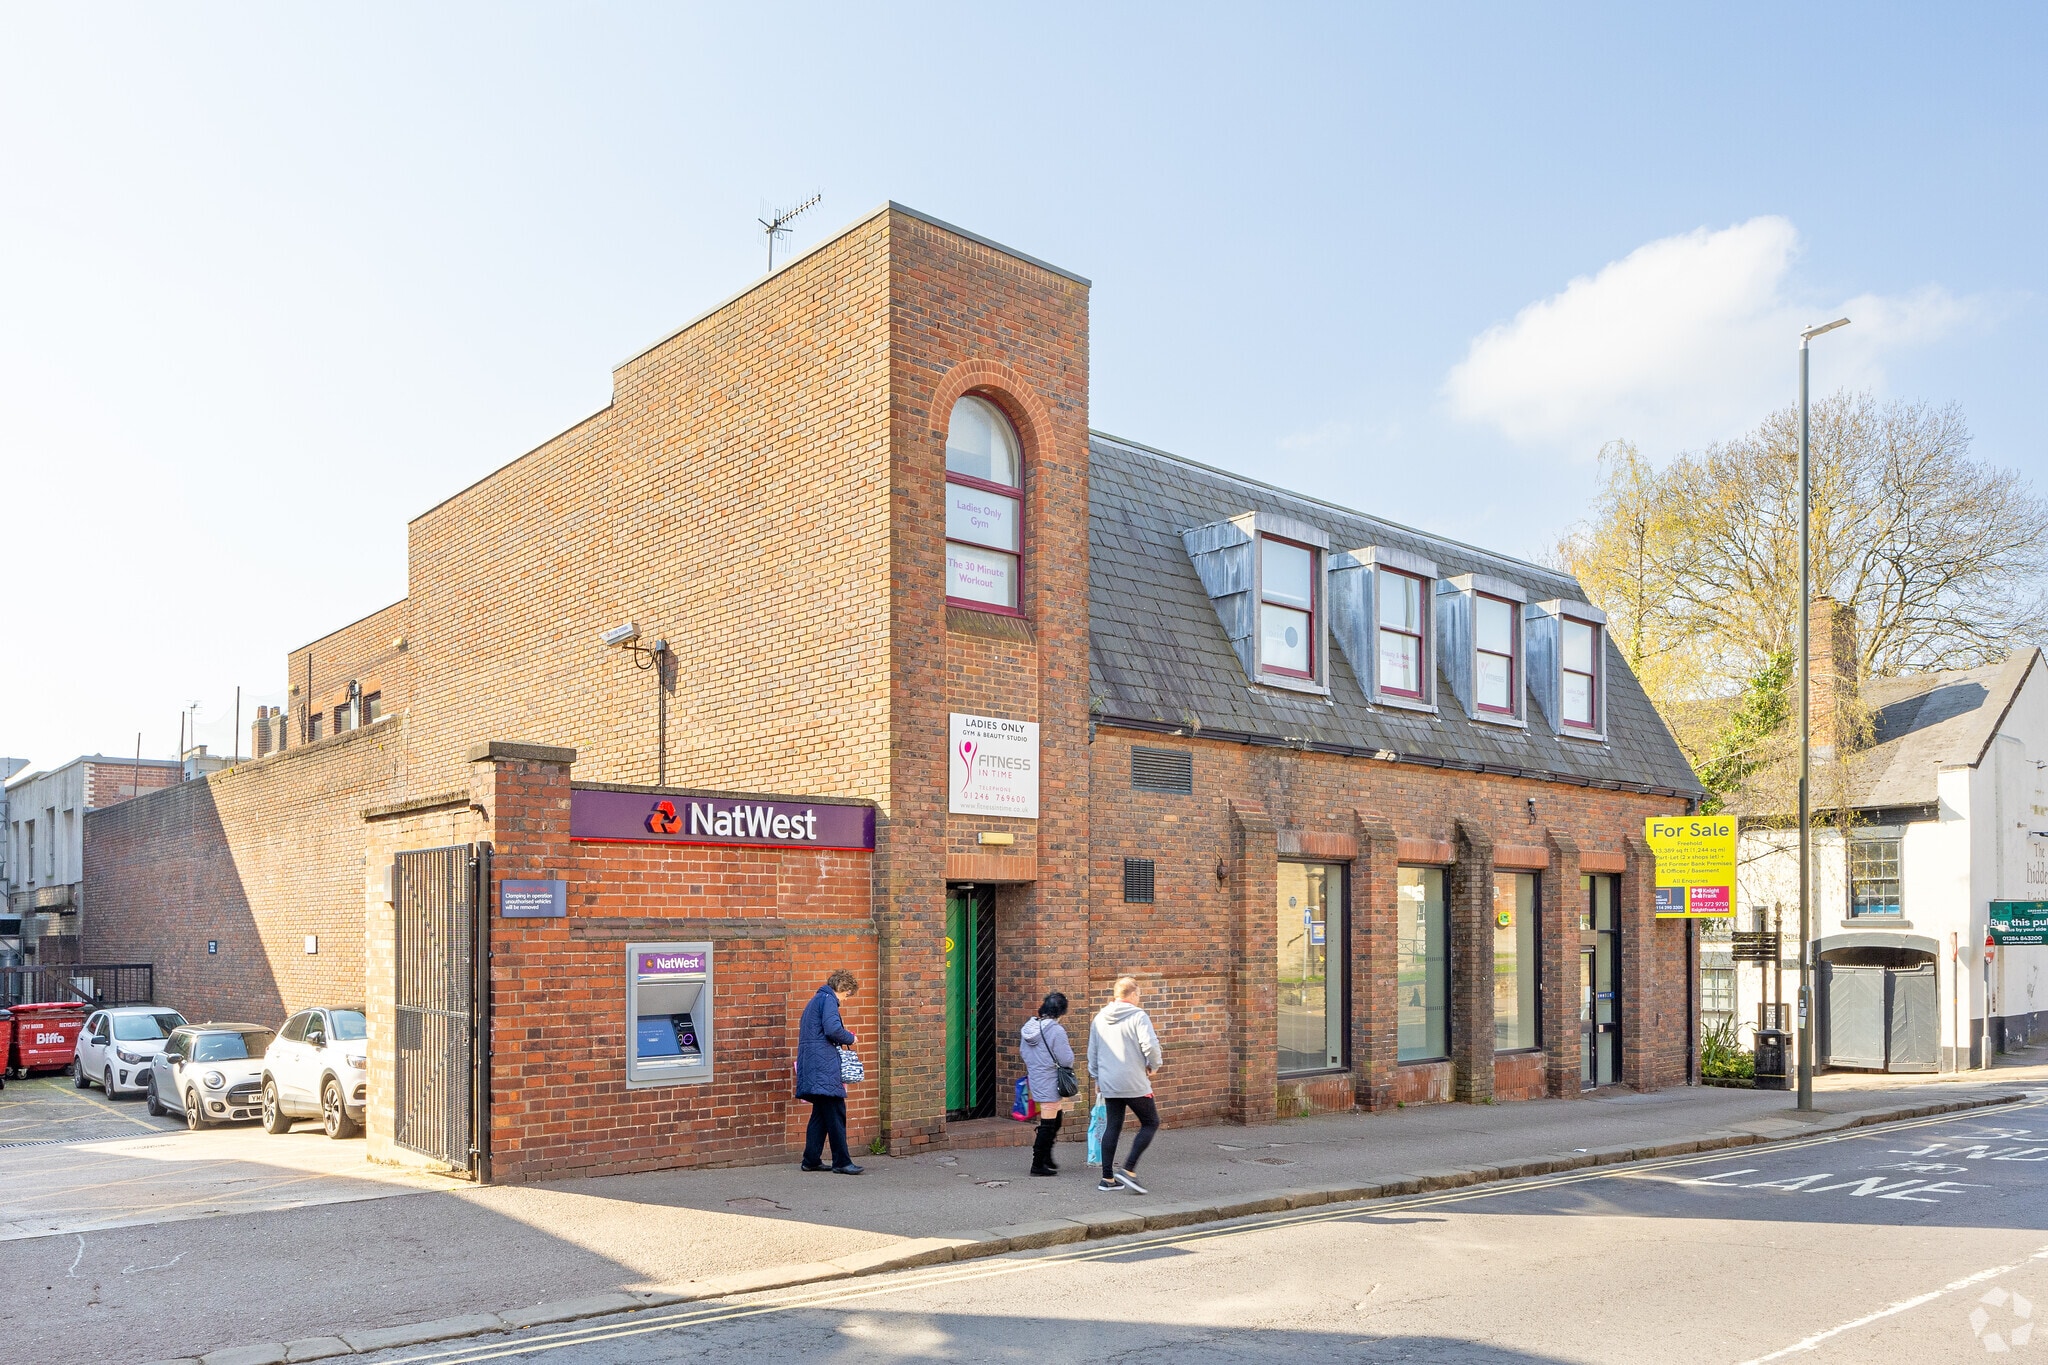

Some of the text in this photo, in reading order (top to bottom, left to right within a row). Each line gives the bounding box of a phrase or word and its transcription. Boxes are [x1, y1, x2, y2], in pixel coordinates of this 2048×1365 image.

[956, 500, 1002, 520] Ladies Only
[970, 517, 989, 528] Gym
[948, 557, 1004, 577] The 30 Minute
[959, 573, 993, 588] Workout
[965, 719, 1025, 733] LADIES ONLY
[983, 732, 1005, 740] BEAUTY
[1006, 734, 1028, 742] STUDIO
[978, 754, 1031, 771] FITNESS
[979, 769, 1012, 779] IN TIME
[963, 791, 1026, 803] 01246 769600
[690, 802, 817, 840] NatWest
[1653, 822, 1730, 837] For Sale
[2033, 842, 2045, 858] The
[1990, 918, 2009, 926] Run
[2011, 918, 2030, 926] this
[656, 957, 699, 969] NatWest
[36, 1032, 65, 1045] Biffa
[1675, 1168, 1993, 1203] LANE
